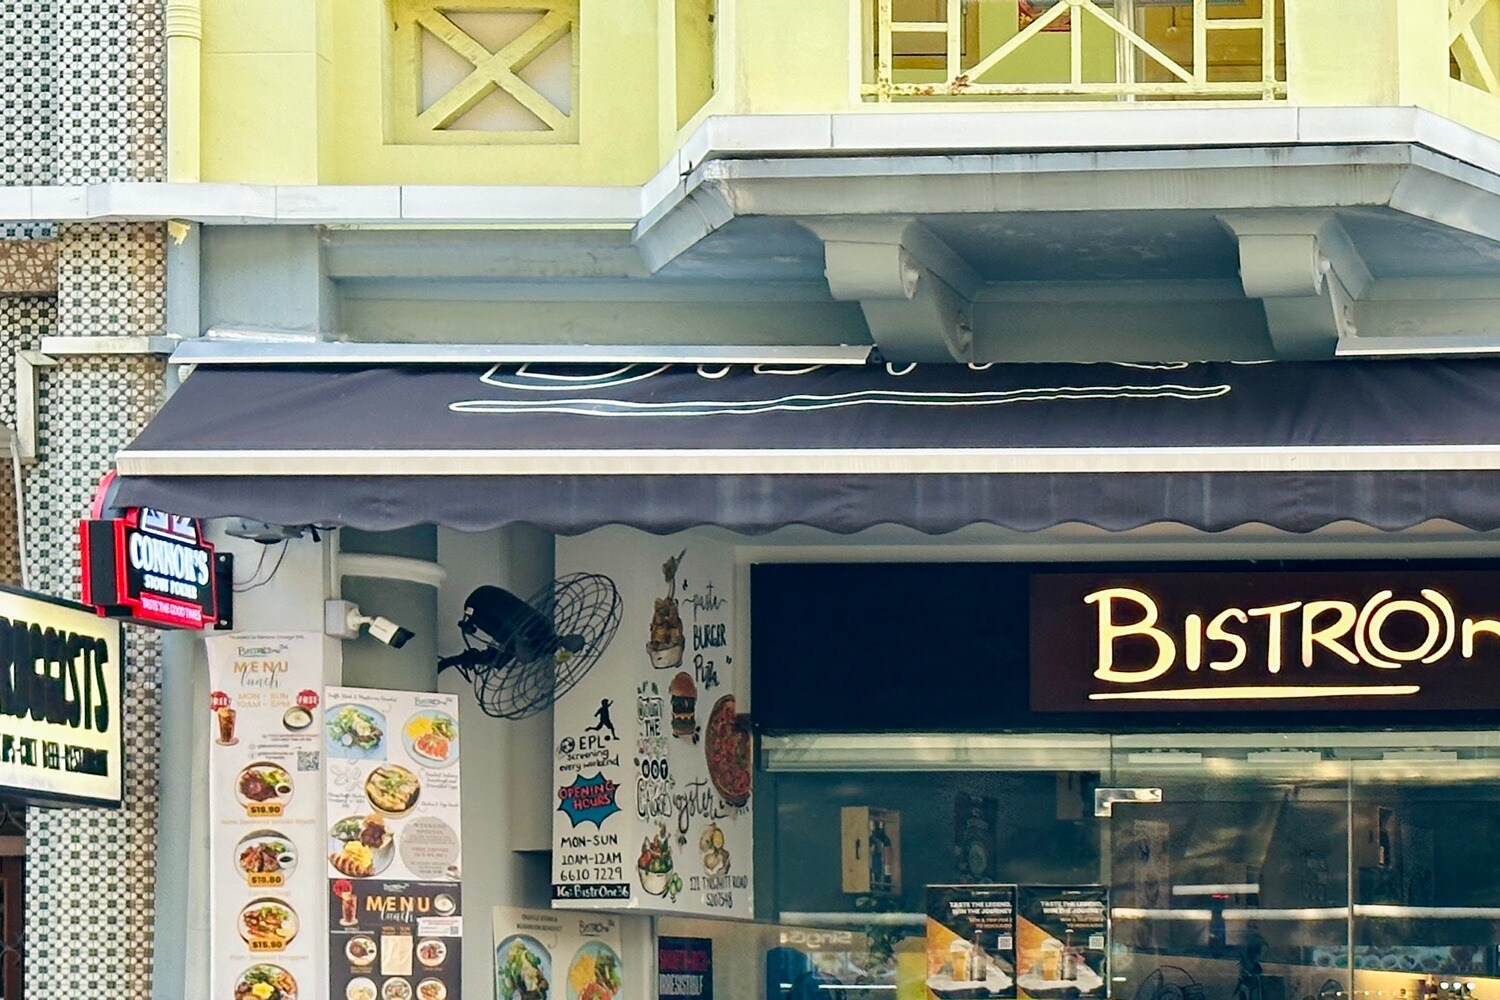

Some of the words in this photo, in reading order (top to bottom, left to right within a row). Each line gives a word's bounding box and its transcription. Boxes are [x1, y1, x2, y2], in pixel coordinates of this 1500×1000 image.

[233, 661, 289, 673] MENU
[579, 735, 605, 750] EPL
[558, 779, 617, 799] OPENING
[573, 793, 612, 810] HOURS
[560, 834, 618, 849] MON-SUN
[561, 852, 622, 866] 10AM-12AM
[560, 869, 590, 881] 6610
[593, 867, 622, 880] 7229
[366, 895, 430, 913] MENU
